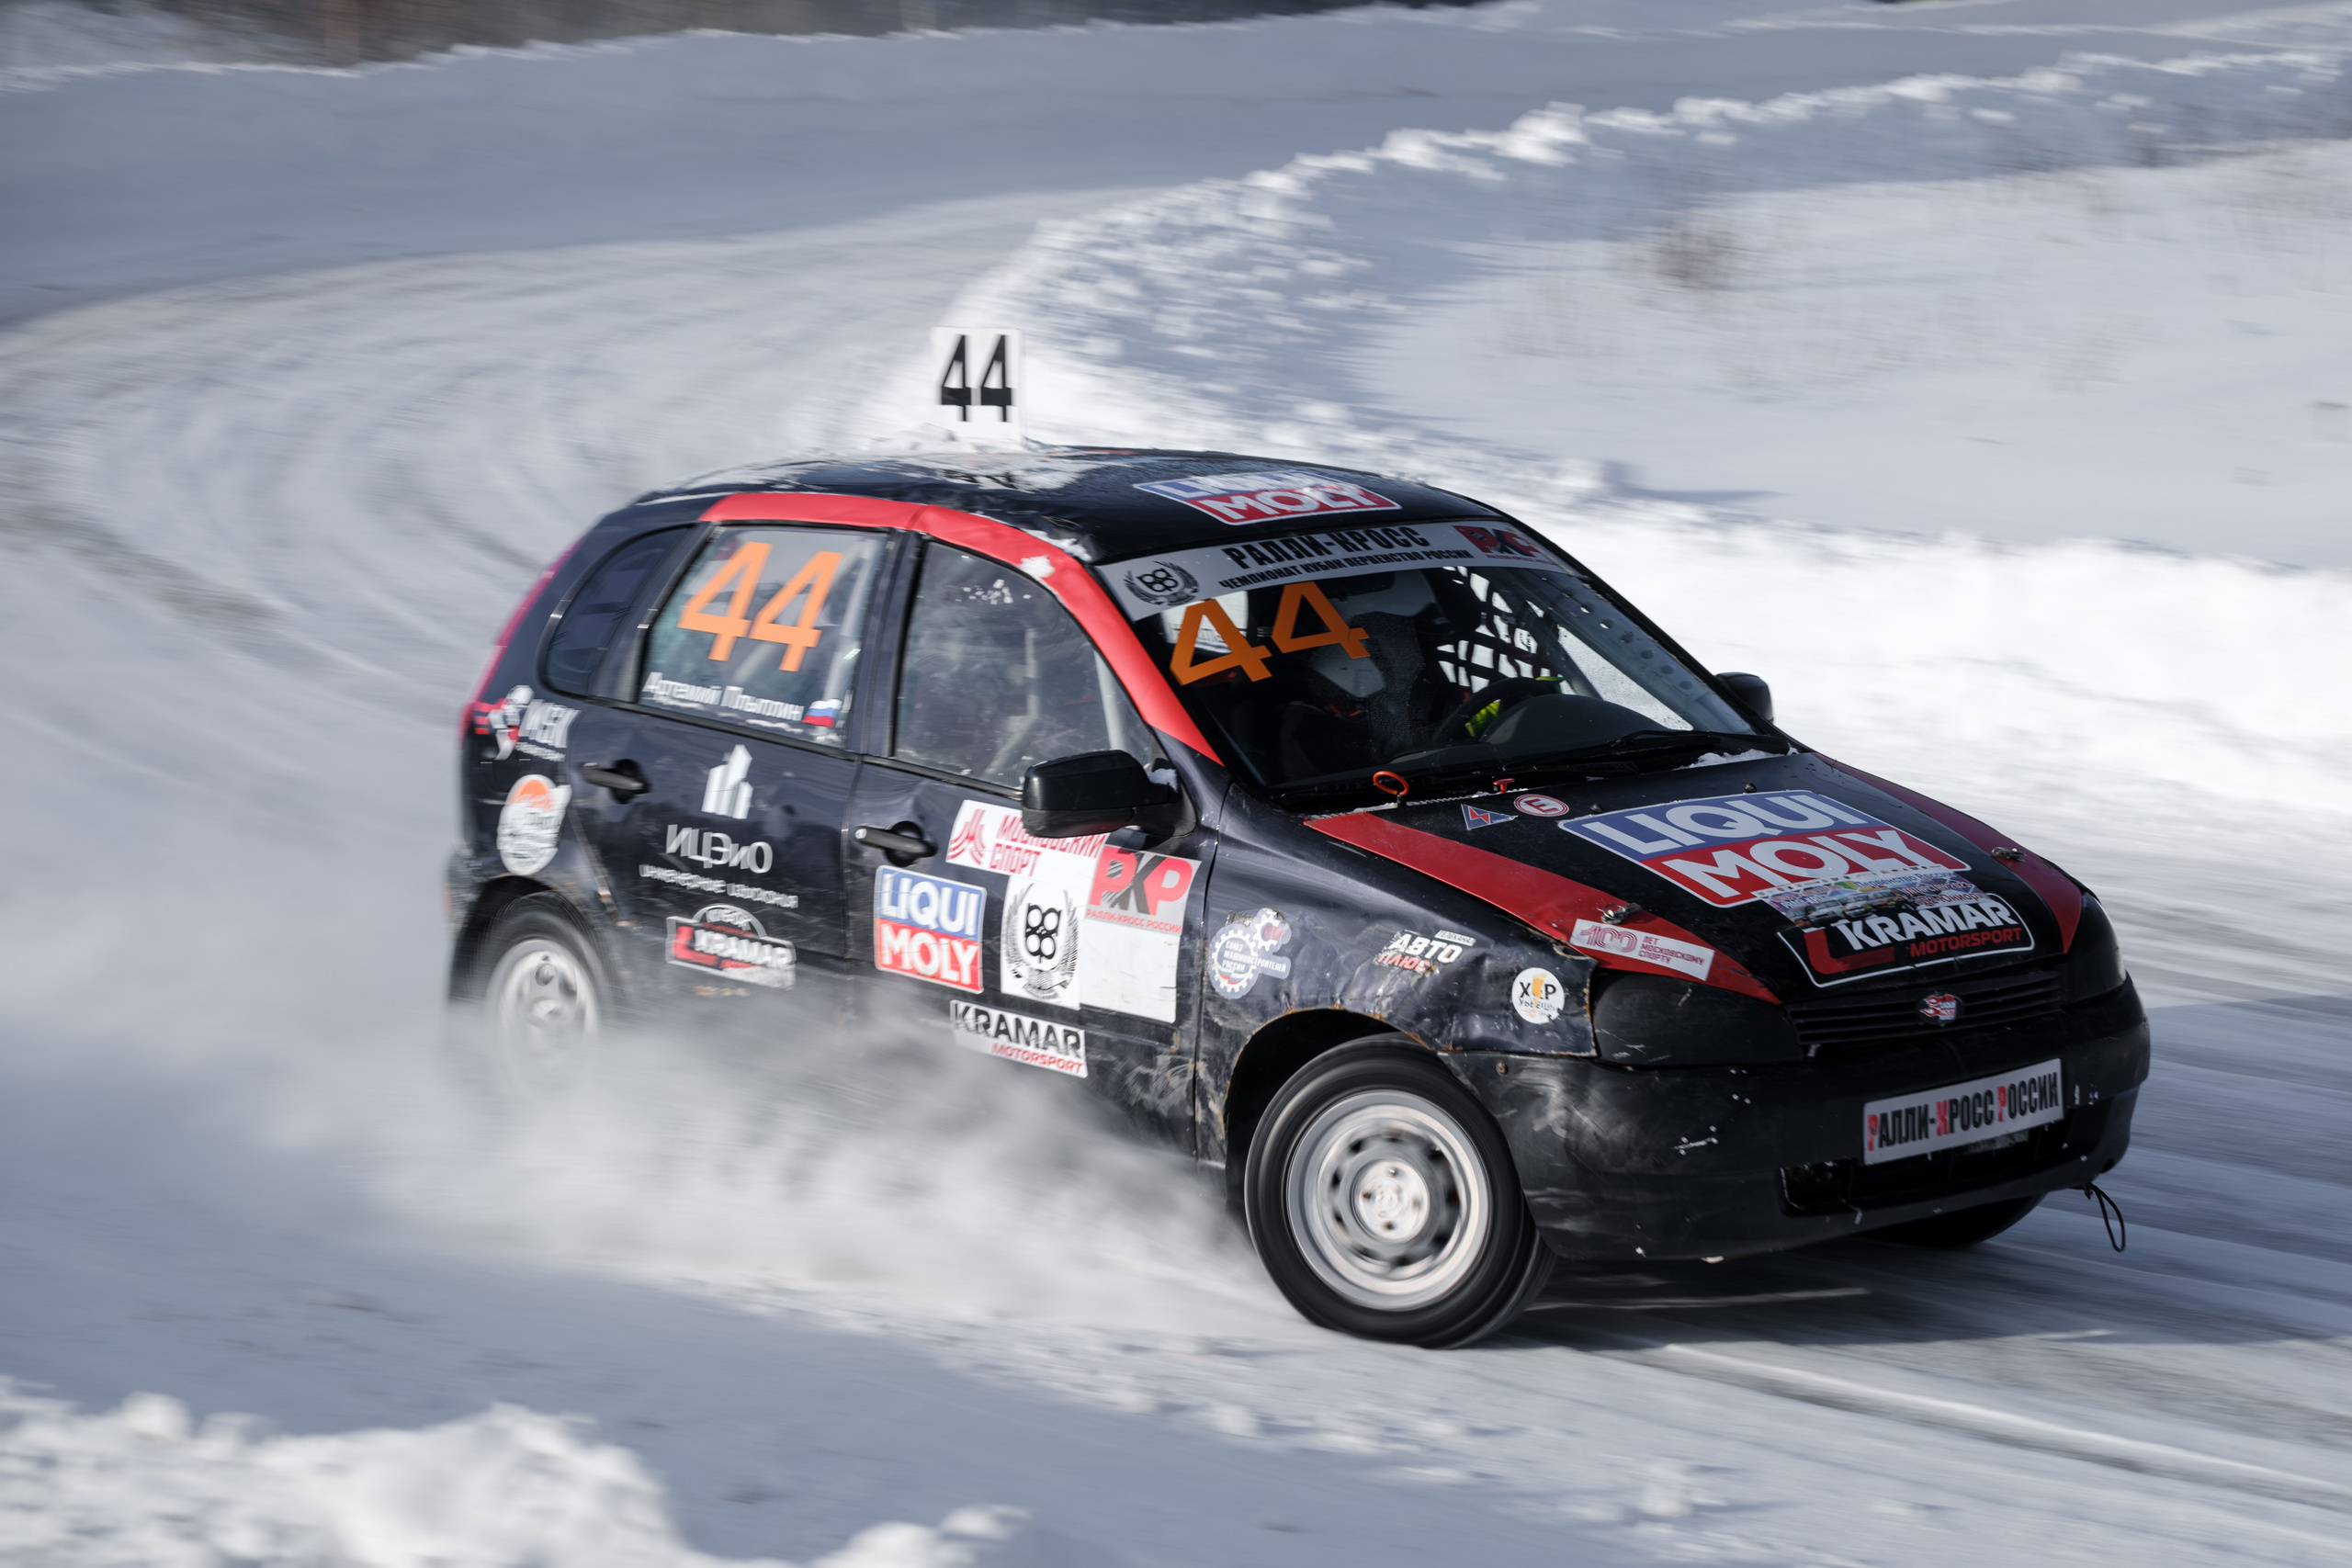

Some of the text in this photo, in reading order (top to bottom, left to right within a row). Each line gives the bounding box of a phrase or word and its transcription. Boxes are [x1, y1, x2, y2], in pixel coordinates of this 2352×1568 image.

[940, 333, 1015, 423] 44
[1197, 485, 1378, 520] MOLY
[1221, 526, 1432, 570] РАЛЛИ-КРОСС
[1219, 566, 1304, 590] ЧЕМПИОНАТ
[1303, 558, 1346, 575] КУБОК
[1345, 550, 1426, 568] ПЕРВЕНСТВО
[1425, 549, 1475, 560] РОССИИ
[676, 540, 843, 672] 44
[1170, 581, 1371, 687] 44
[1524, 797, 1557, 813] E
[1581, 795, 1869, 855] LIQUI
[989, 842, 1042, 877] СПОРТ
[1661, 830, 1940, 899] MOLY
[879, 873, 980, 937] LIQUI
[1086, 908, 1182, 934] РАЛЛИ-КРОСС РОССИИ
[1579, 924, 1638, 953] 100
[1642, 935, 1659, 946] ЛЕТ
[1834, 901, 2019, 951] KRAMAR
[1910, 927, 2022, 958] MOTORSPORT
[881, 922, 980, 985] MOLY
[1223, 950, 1287, 974] МАШИНОСТРОИТЕЛЕЙ
[1225, 940, 1244, 952] СОЮЗ
[1377, 952, 1431, 974] ПЛЮС
[1388, 932, 1464, 964] АВТО
[1638, 951, 1672, 964] СПОРТУ
[1640, 943, 1705, 965] МОСКОВСКОМУ
[1221, 958, 1246, 973] РОССИИ
[1519, 981, 1557, 1000] ХР
[953, 1004, 1082, 1059] KRAMAR
[991, 1042, 1084, 1075] MOTORSPORT
[1868, 1071, 2059, 1152] РАЛЛИ-КРОСС РОССИИ
